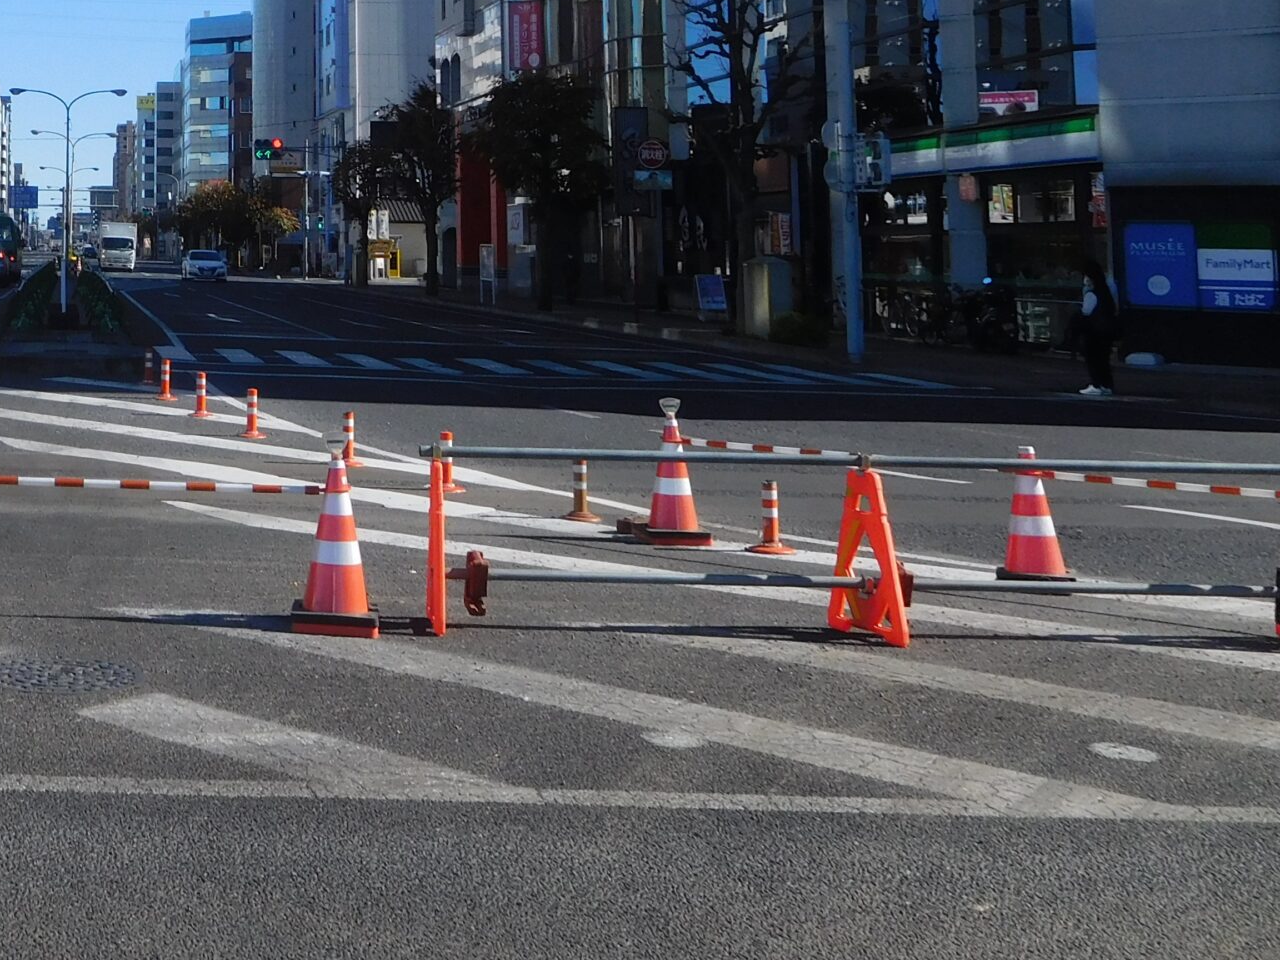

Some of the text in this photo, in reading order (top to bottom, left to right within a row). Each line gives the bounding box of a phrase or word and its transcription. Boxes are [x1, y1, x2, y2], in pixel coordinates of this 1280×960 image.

[1205, 258, 1272, 272] FamilyMart
[1215, 291, 1267, 306] 酒 たばこ
